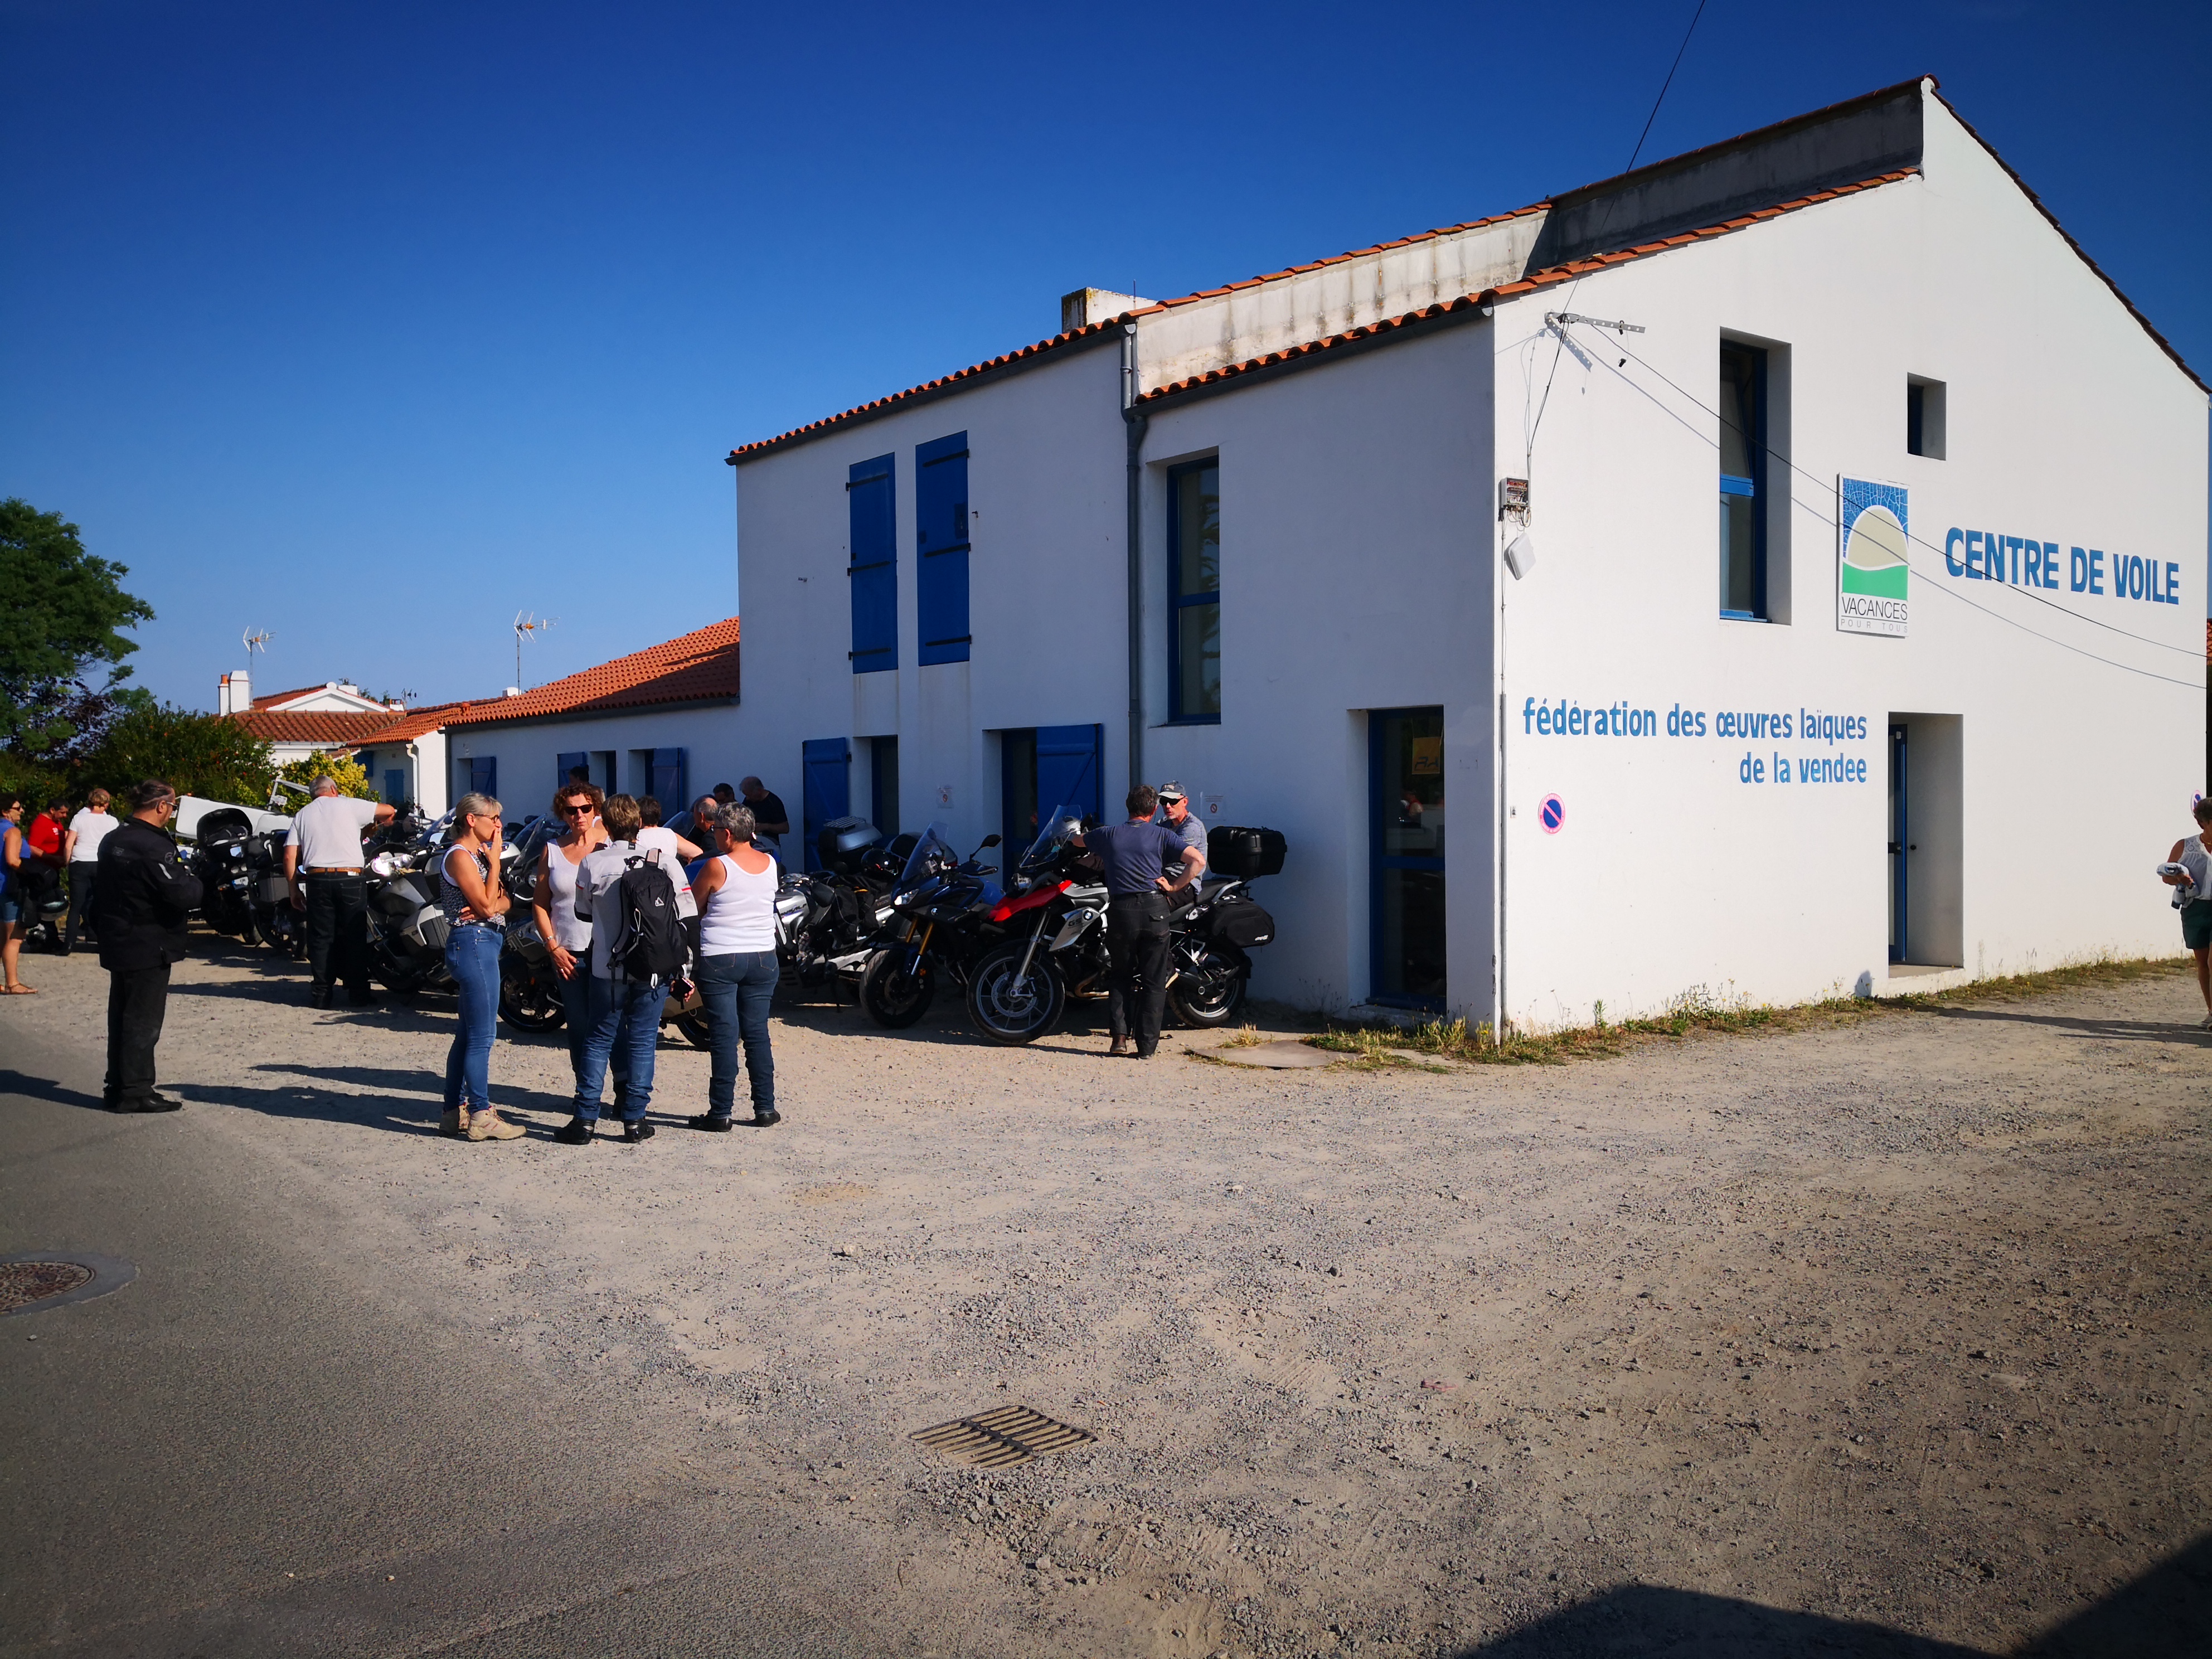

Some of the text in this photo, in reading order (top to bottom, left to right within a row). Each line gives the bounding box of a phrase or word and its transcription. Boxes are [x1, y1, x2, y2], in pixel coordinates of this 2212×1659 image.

[1945, 527, 2179, 605] CENTRE DE VOILE
[1841, 596, 1908, 620] VACANCES
[1841, 619, 1908, 633] POUR TOUS
[1523, 696, 1867, 746] fédération des œuvres laïques
[1740, 751, 1867, 784] de la vendee
